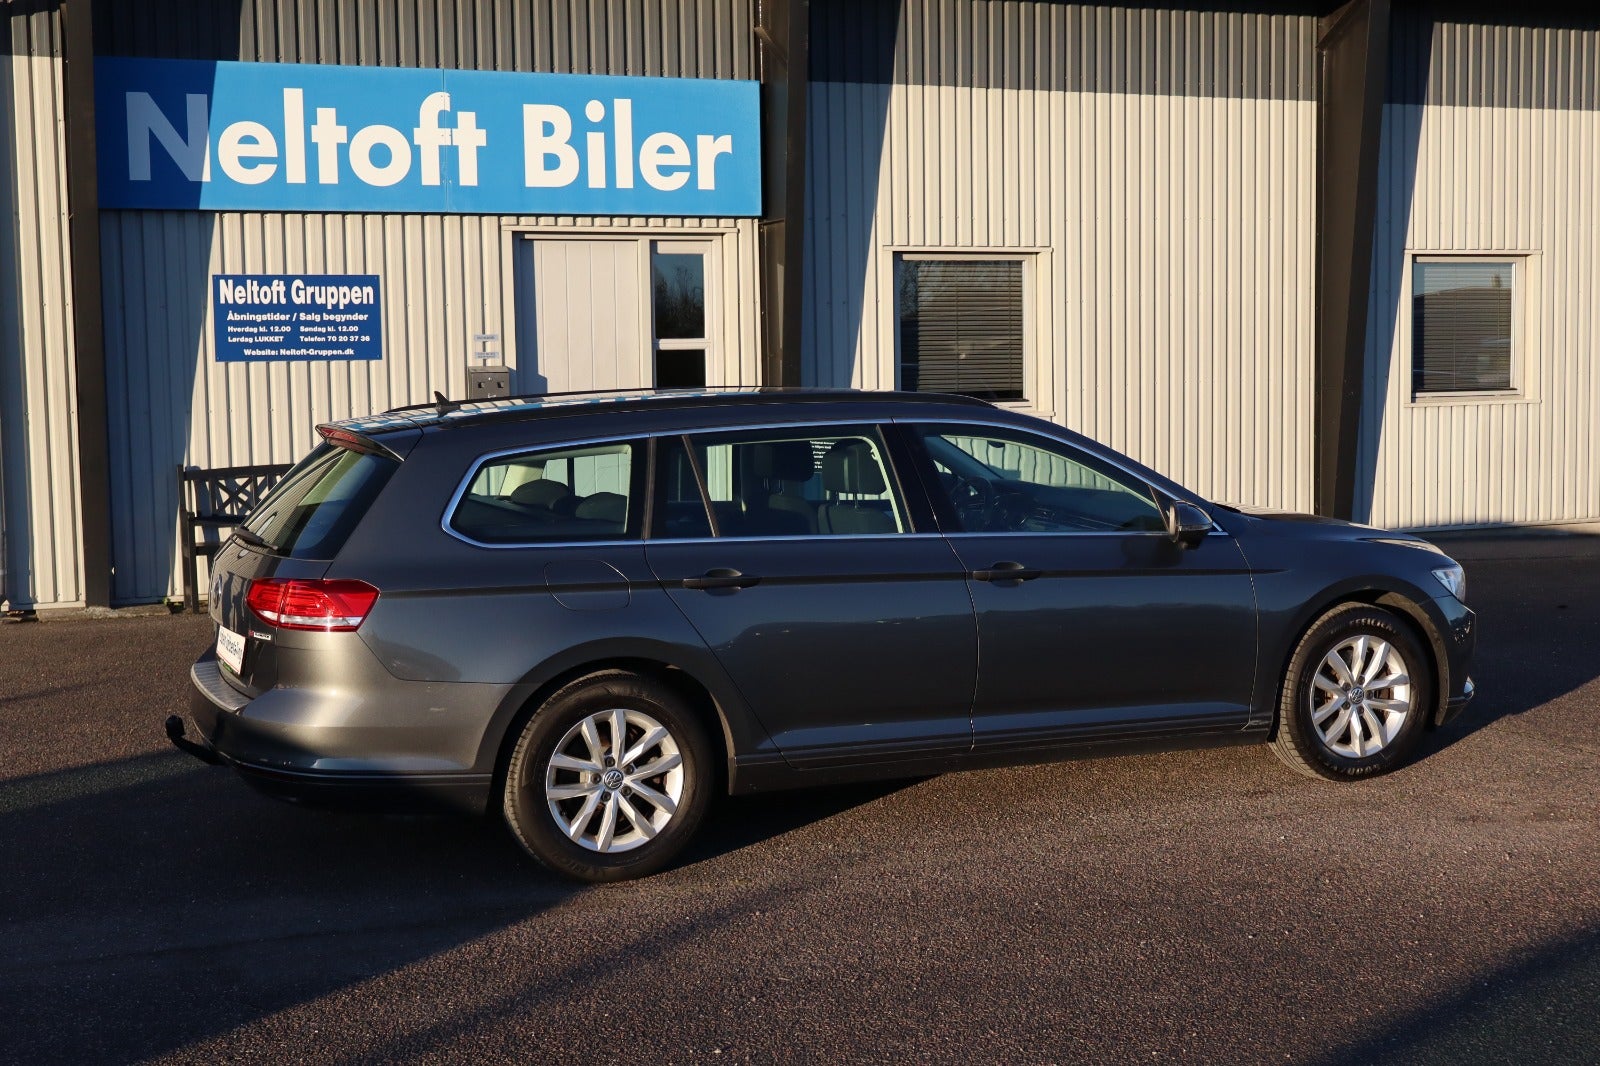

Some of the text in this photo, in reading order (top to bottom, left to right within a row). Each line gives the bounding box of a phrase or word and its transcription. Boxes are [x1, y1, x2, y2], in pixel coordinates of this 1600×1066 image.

[124, 86, 734, 192] Neltoft Biler
[220, 279, 373, 309] Neltoft Gruppen
[227, 310, 368, 322] Åbningstider / Salg begynder
[228, 326, 258, 334] Hverdag
[300, 326, 326, 334] Søndag
[228, 336, 254, 344] Lørdag
[280, 348, 354, 356] Neltoft-Gruppen.dk
